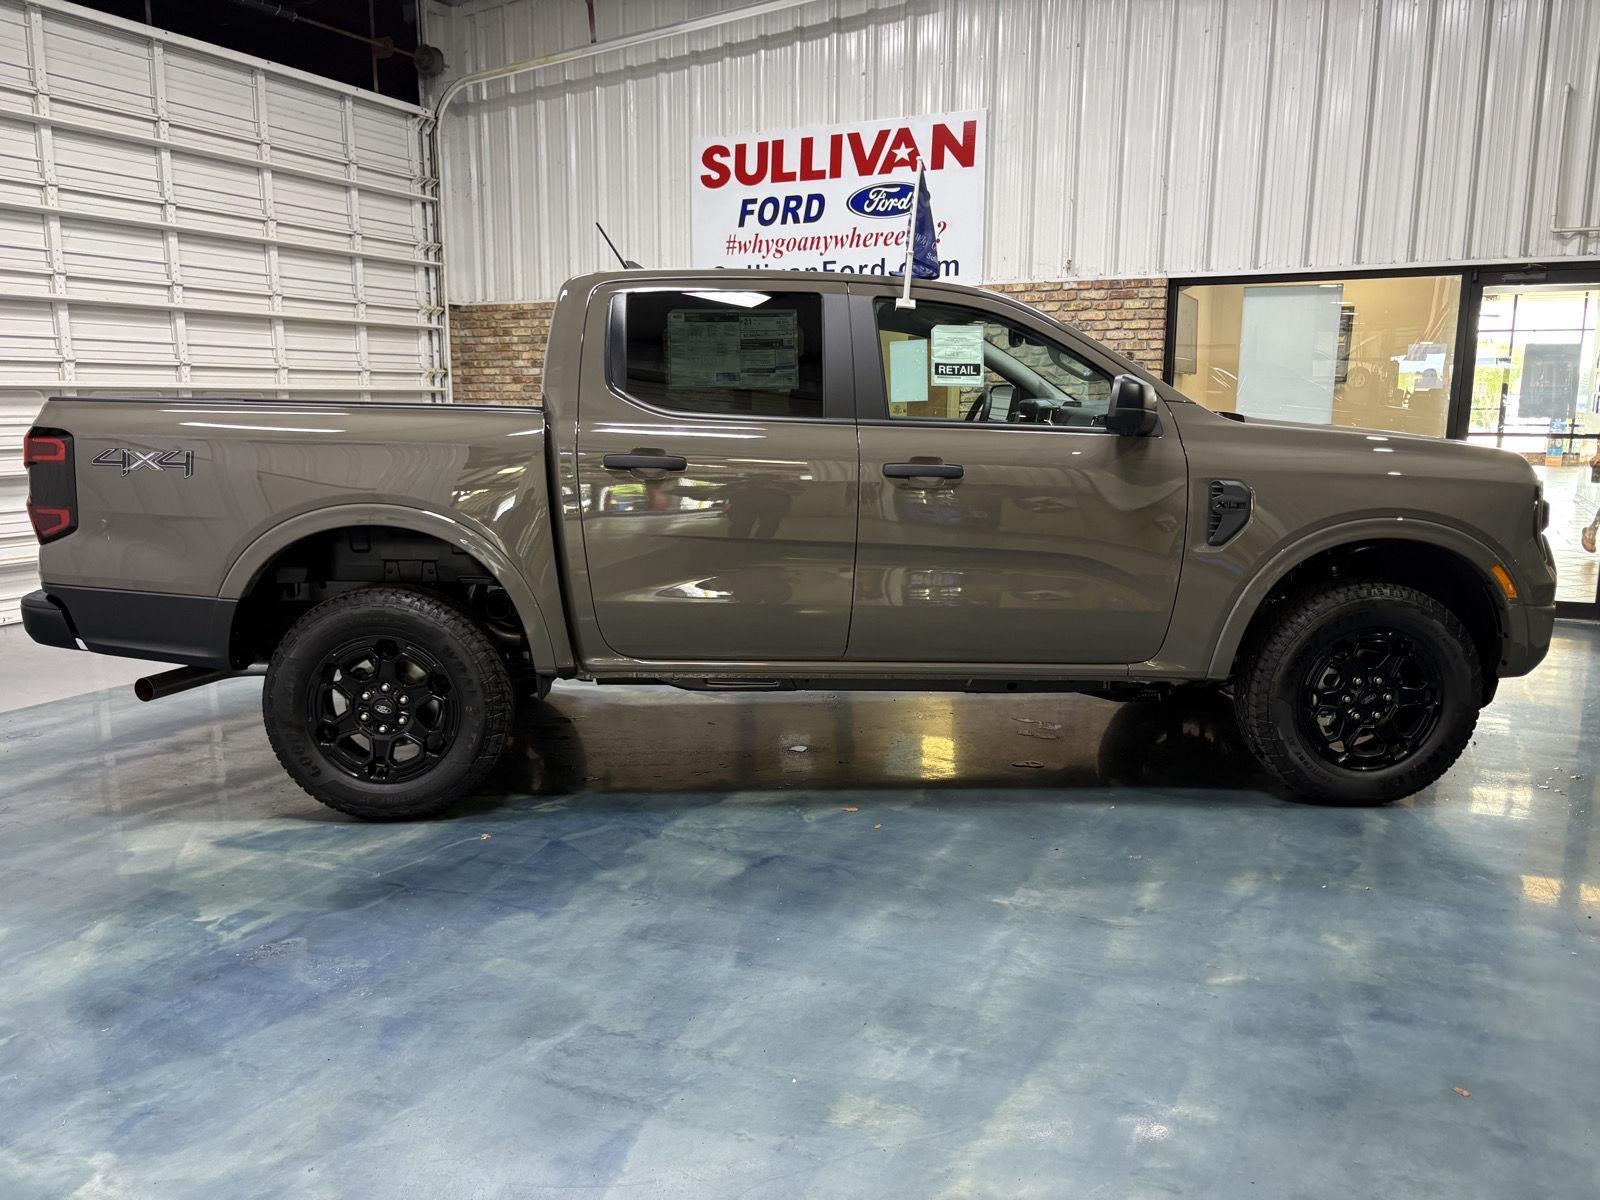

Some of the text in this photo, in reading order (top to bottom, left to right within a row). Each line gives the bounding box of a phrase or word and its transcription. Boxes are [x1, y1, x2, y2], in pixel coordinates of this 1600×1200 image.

[700, 120, 977, 189] SULLIVAN
[738, 193, 825, 228] FORD
[863, 187, 914, 213] Ford
[938, 365, 977, 375] RETAIL
